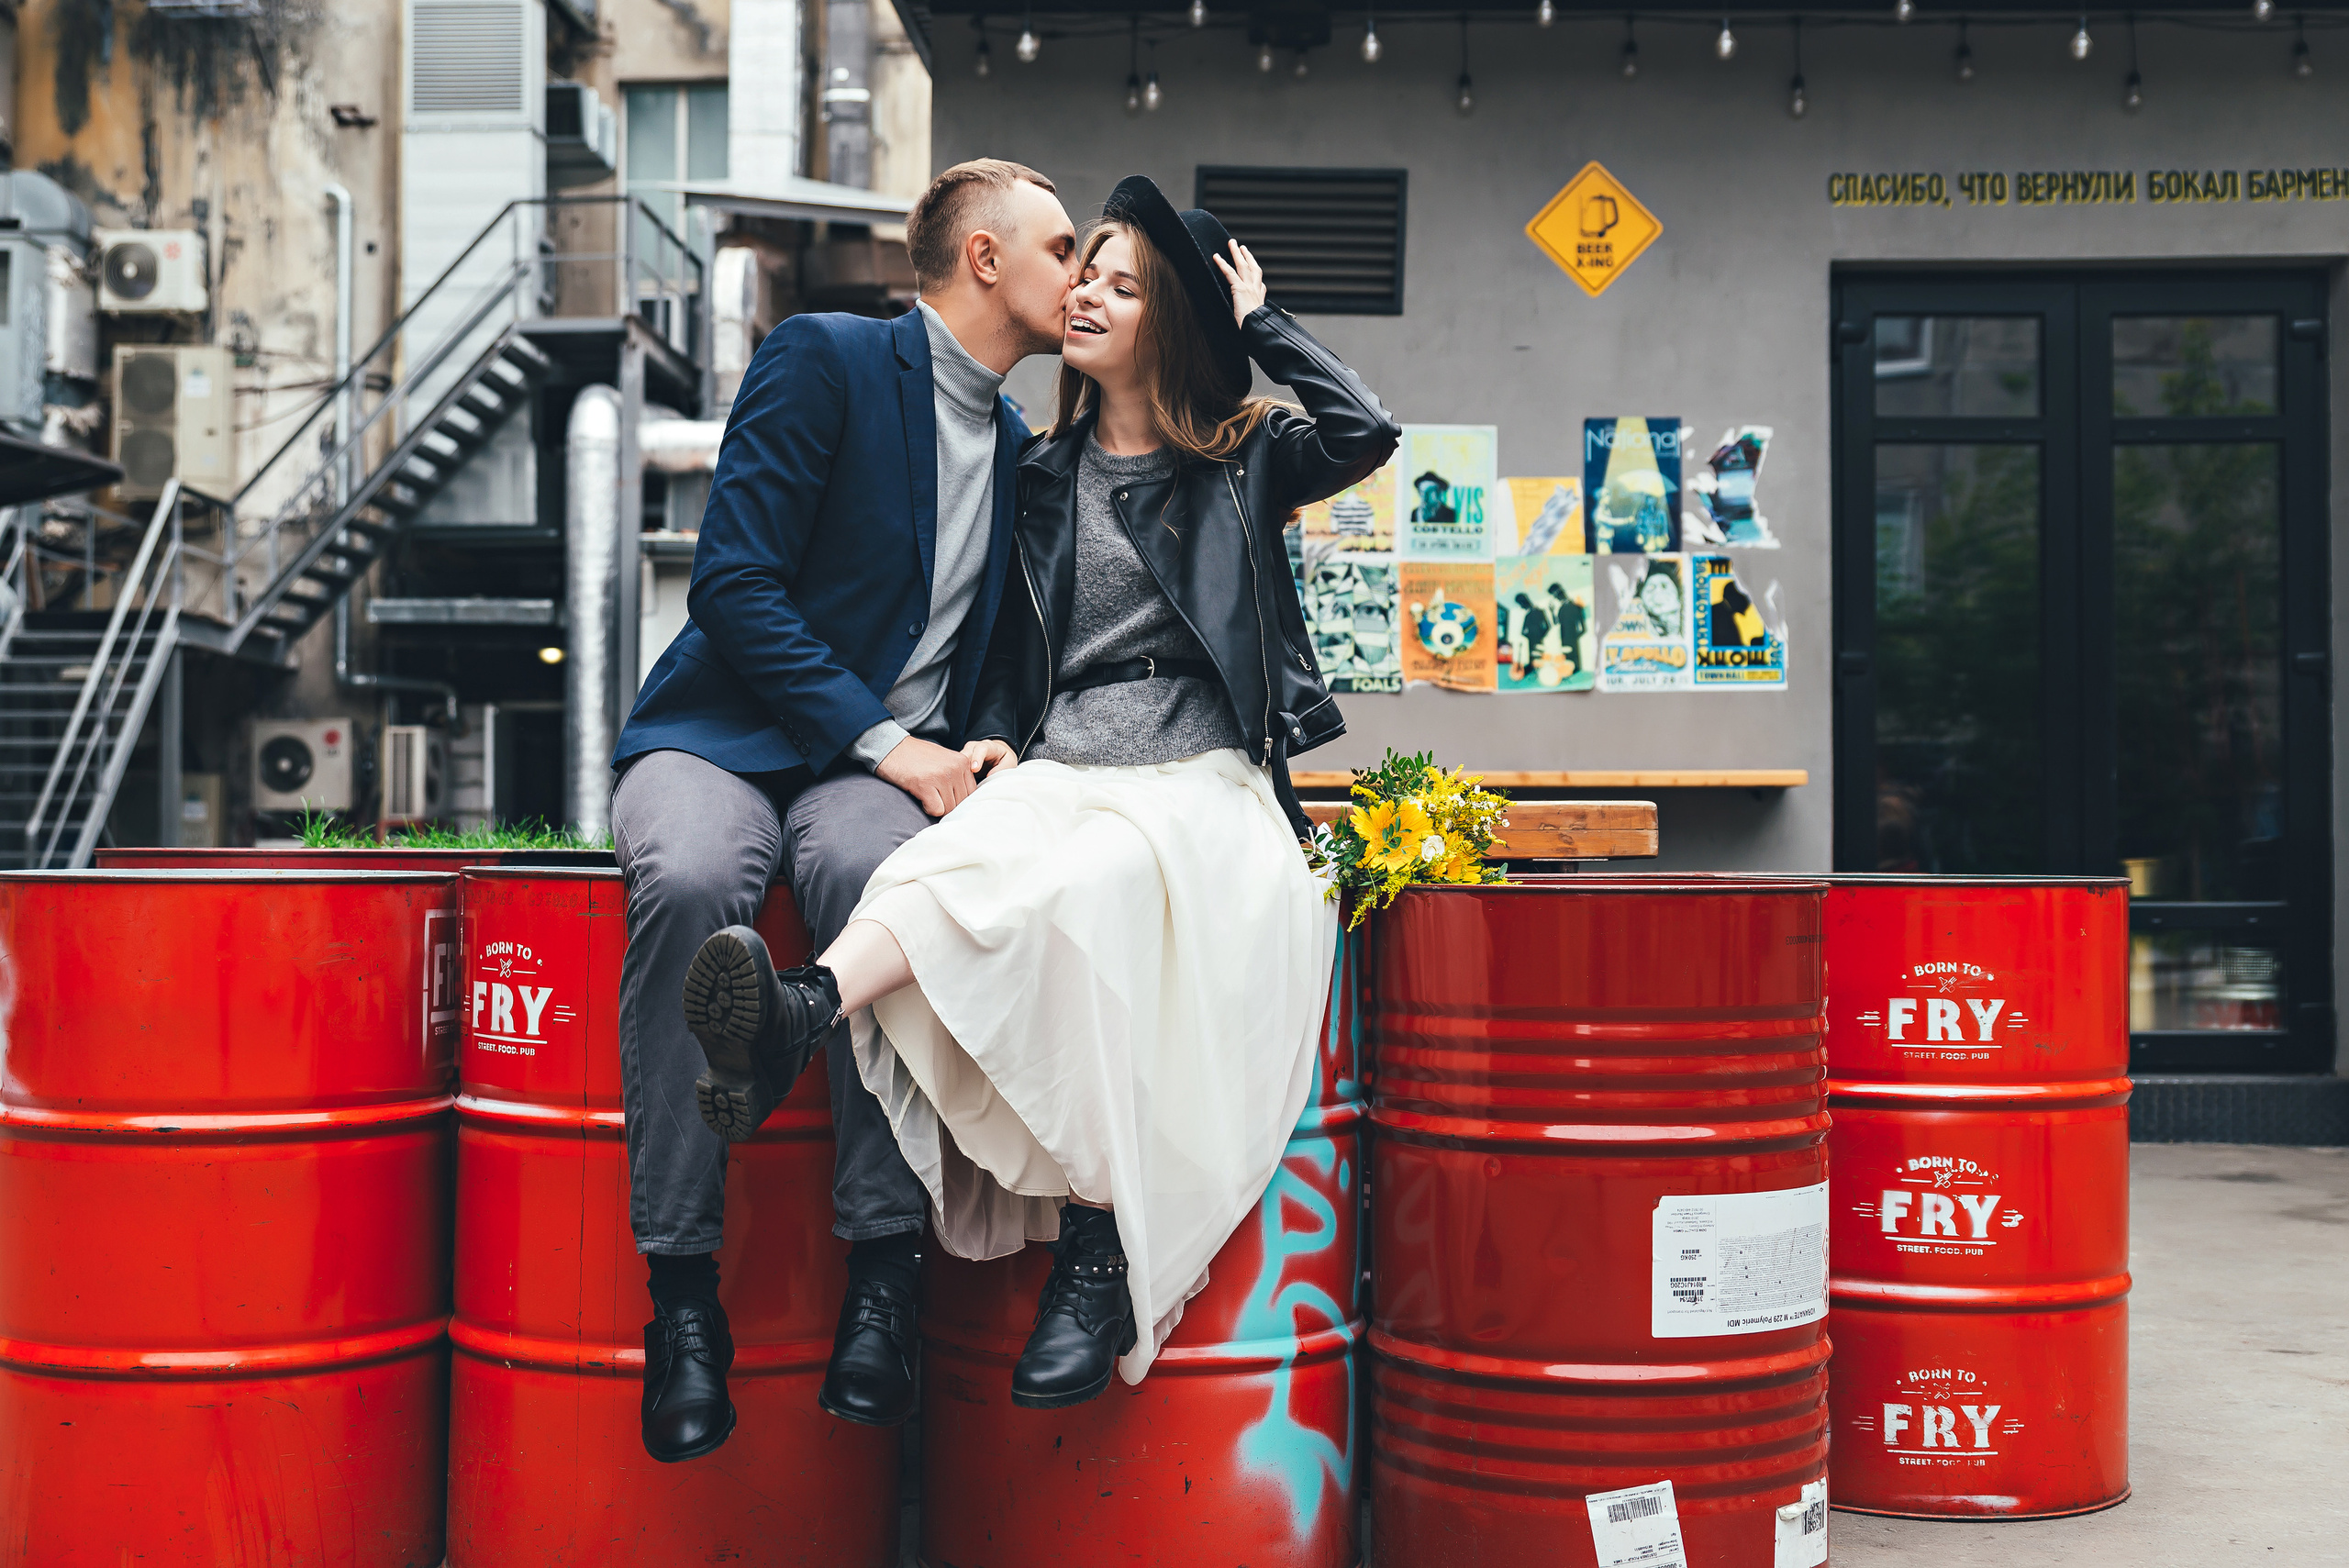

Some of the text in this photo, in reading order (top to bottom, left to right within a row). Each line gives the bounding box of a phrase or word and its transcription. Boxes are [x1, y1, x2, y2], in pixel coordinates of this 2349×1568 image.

[1829, 172, 1954, 210] СПАСИБО,
[1958, 172, 2009, 206] ЧТО
[2017, 170, 2137, 206] ВЕРНУЛИ
[2147, 169, 2242, 204] БОКАЛ
[1575, 243, 1612, 254] BEER
[1352, 678, 1401, 693] FOALS
[485, 941, 532, 961] BORN TO
[1914, 962, 1982, 977] BORN TO
[472, 980, 553, 1036] FRY
[1887, 997, 2006, 1041] FRY
[519, 1047, 535, 1056] PUB
[1908, 1156, 1977, 1174] BORN TO
[1881, 1189, 2001, 1238] FRY
[1965, 1248, 1984, 1256] PUB
[1727, 1319, 1741, 1328] MDI
[1742, 1315, 1773, 1326] Polymeric
[1773, 1314, 1783, 1323] 229
[1909, 1368, 1976, 1384] BORN TO
[1882, 1403, 2002, 1448] FRY
